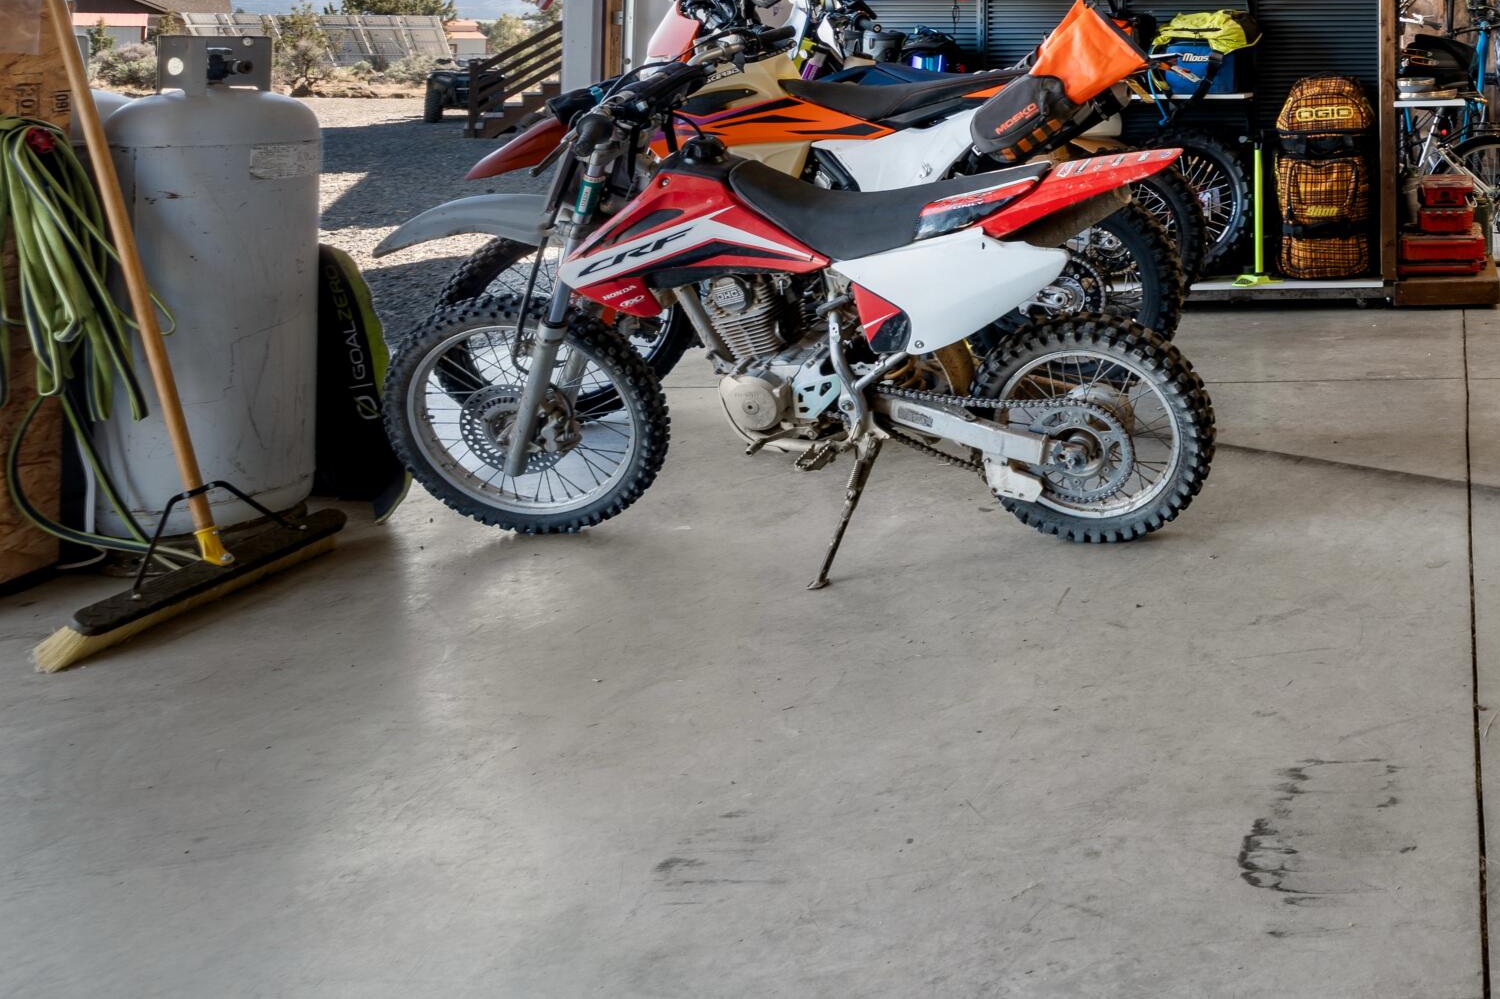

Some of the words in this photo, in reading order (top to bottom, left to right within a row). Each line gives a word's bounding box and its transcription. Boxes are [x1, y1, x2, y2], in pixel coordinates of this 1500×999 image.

[1182, 52, 1209, 62] Moos
[995, 102, 1038, 136] MOSKO
[1296, 105, 1354, 122] OGIO
[577, 225, 695, 278] CRF
[602, 284, 638, 301] HONDA
